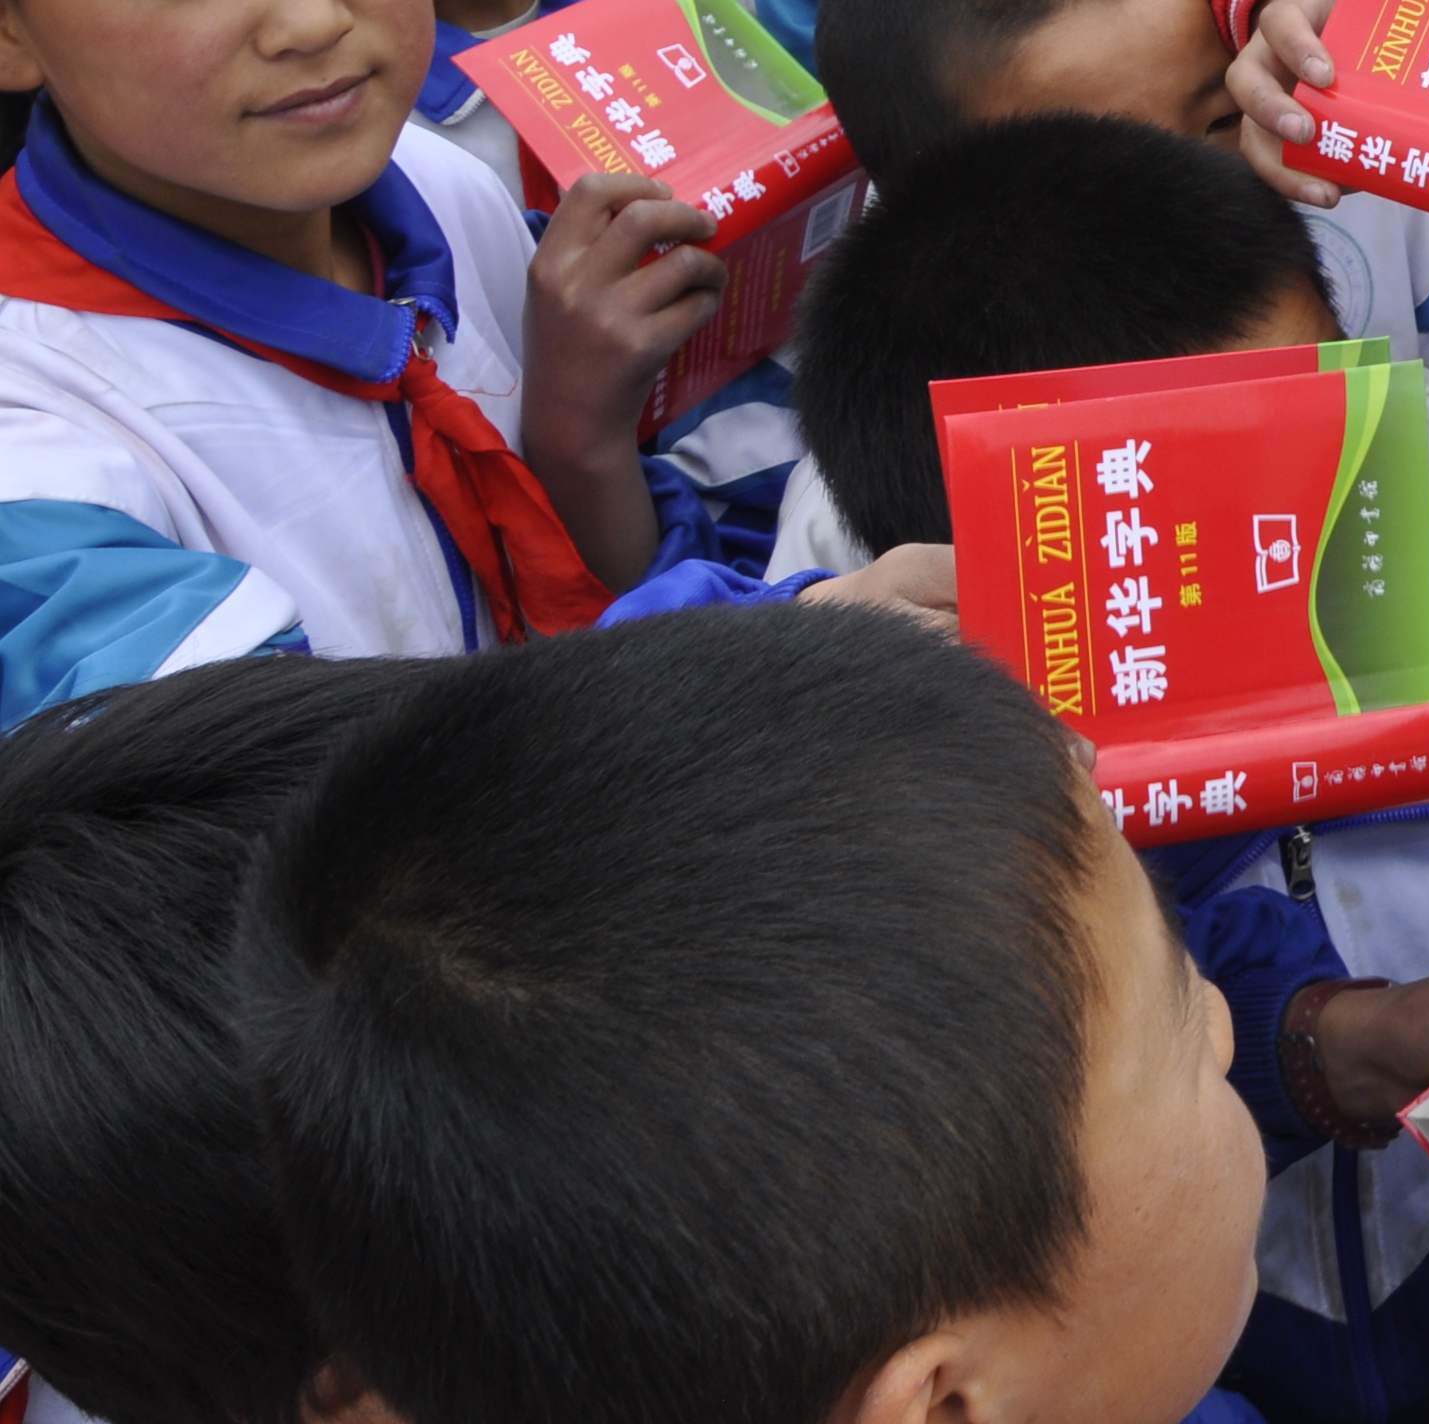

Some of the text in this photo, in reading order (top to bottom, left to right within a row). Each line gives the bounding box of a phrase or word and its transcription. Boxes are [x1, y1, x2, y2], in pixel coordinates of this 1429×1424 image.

[548, 32, 677, 169] 新华字典
[1096, 439, 1169, 706] 新华字典
[1174, 521, 1203, 609] 第11版
